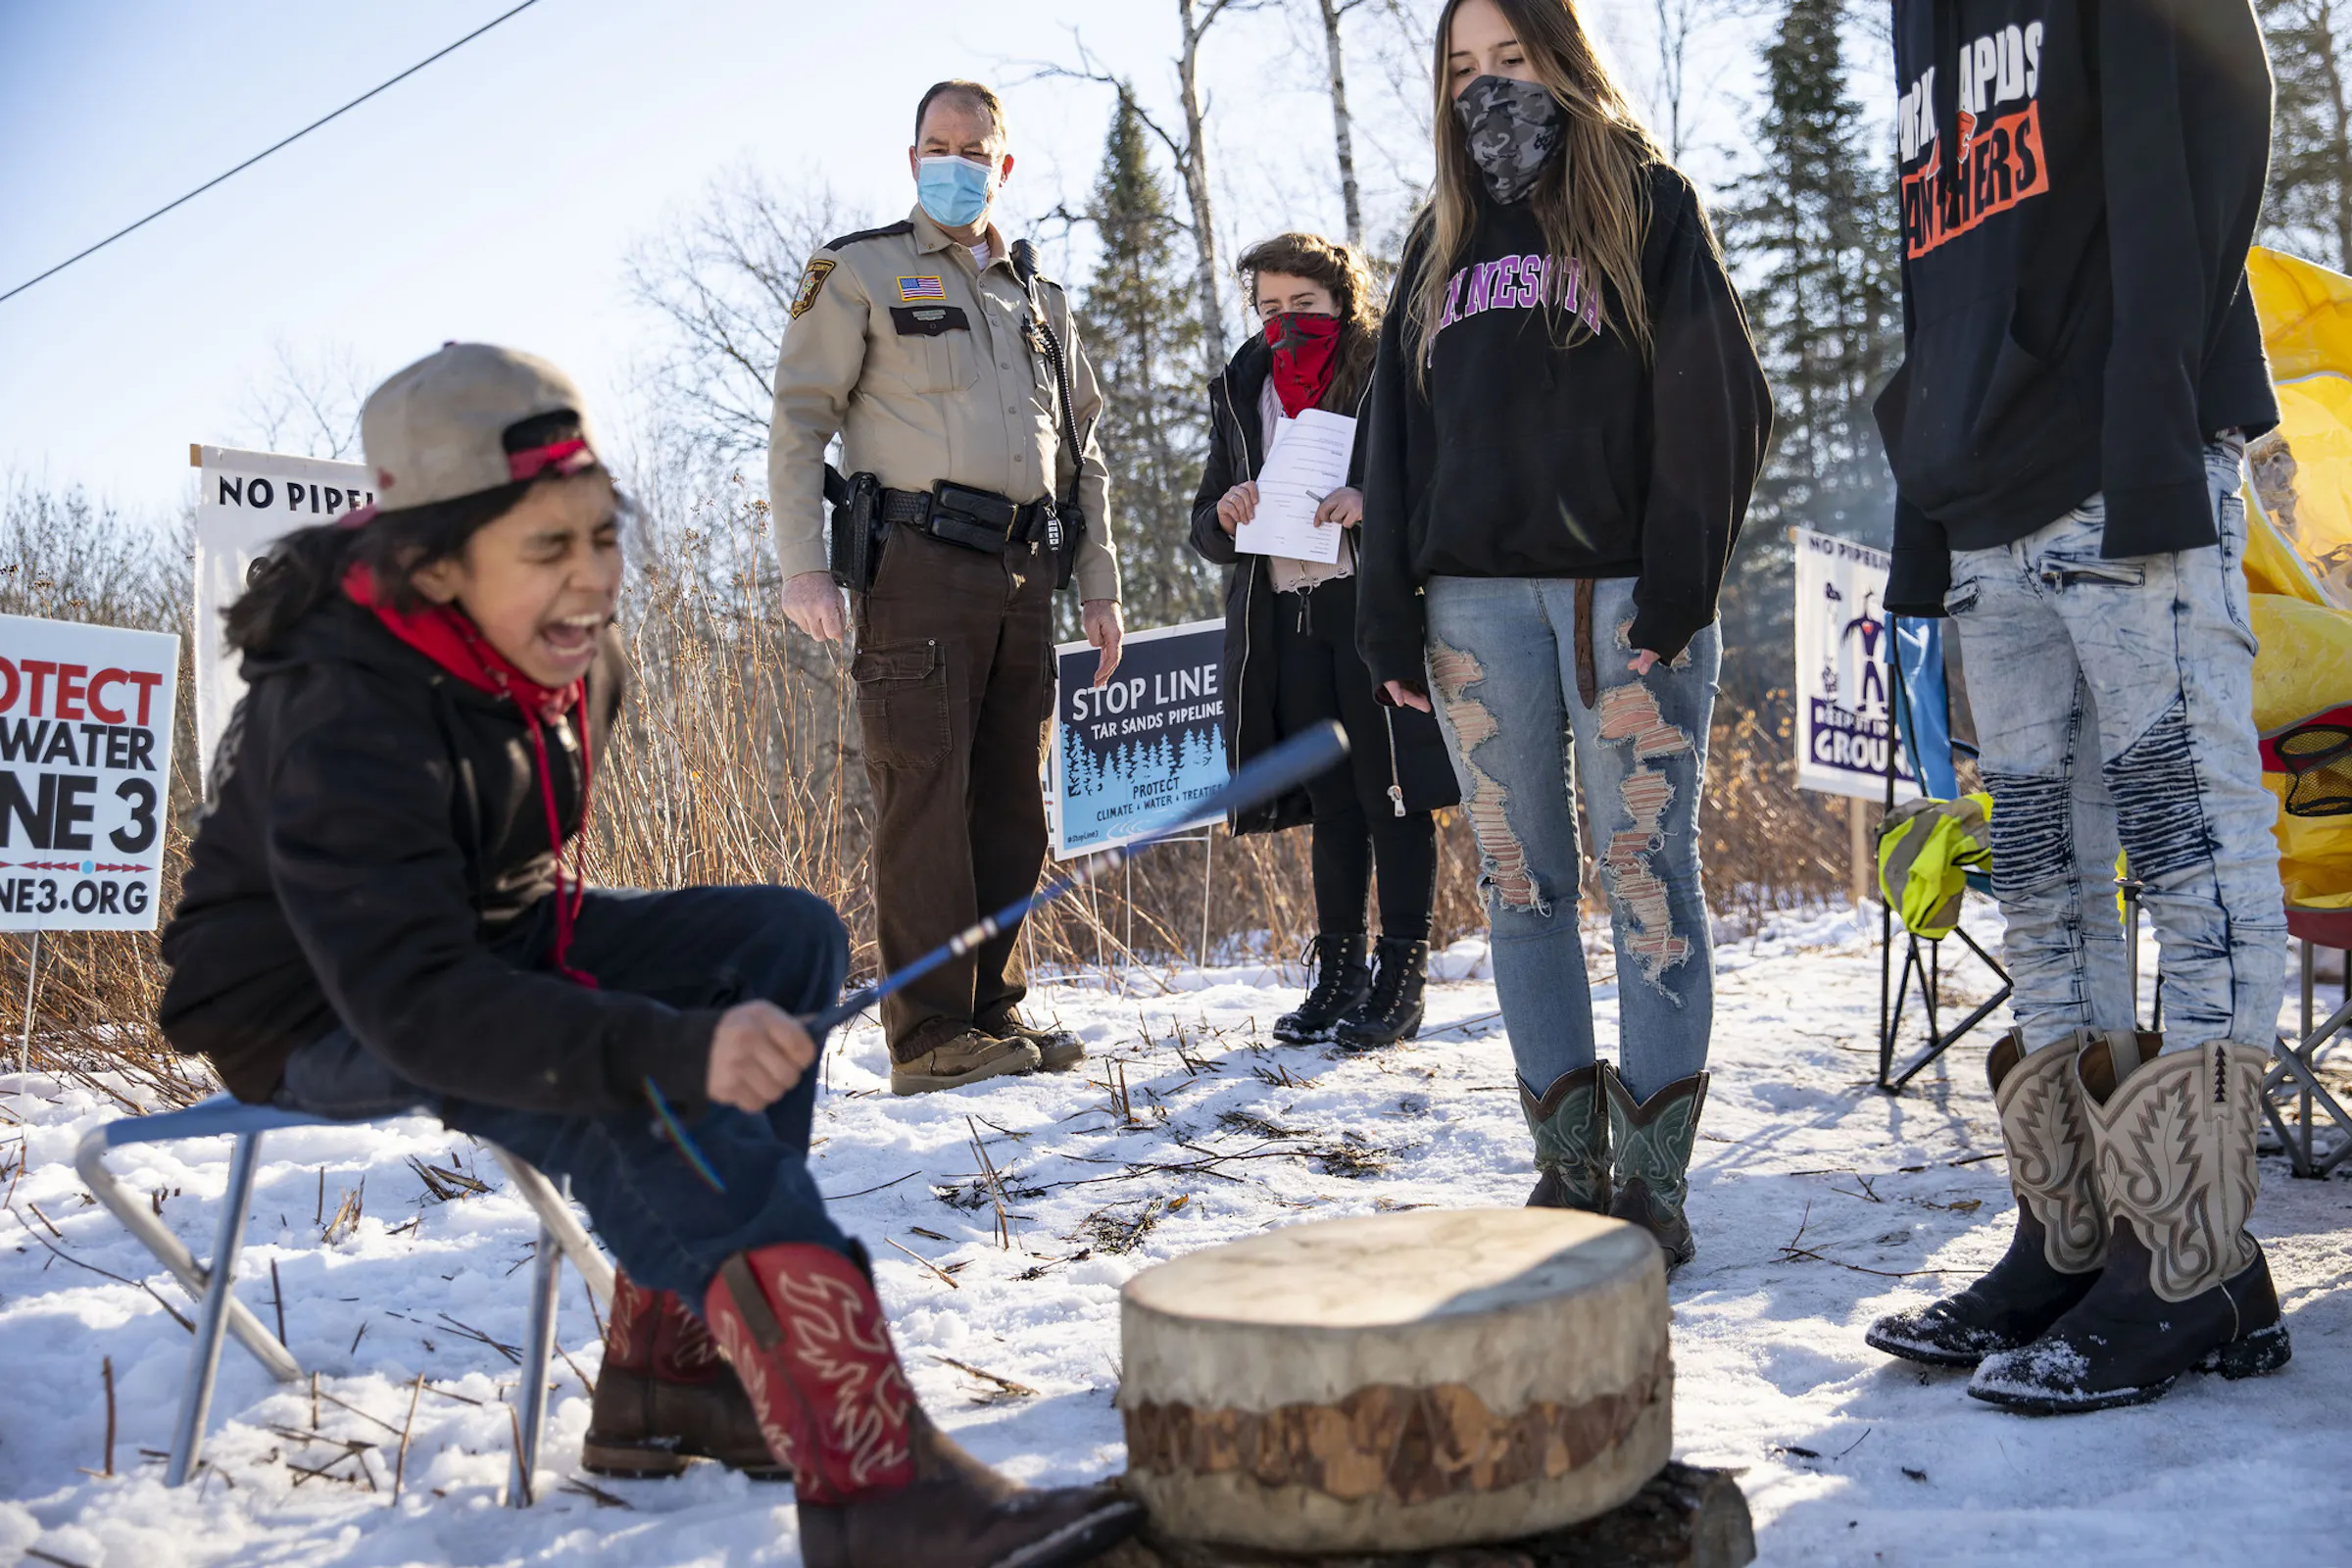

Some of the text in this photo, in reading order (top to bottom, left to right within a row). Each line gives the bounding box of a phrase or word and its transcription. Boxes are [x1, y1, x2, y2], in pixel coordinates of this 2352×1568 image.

[219, 475, 274, 509] NO
[1810, 538, 1835, 556] NO
[1072, 663, 1218, 721] STOP LINE
[1091, 700, 1224, 740] TAR SANDS PIPELINE
[0, 716, 157, 771] WATER
[1133, 777, 1180, 800] PROTECT
[109, 777, 158, 855] 3
[1097, 803, 1134, 822] CLIMATE
[1144, 795, 1173, 810] WATER
